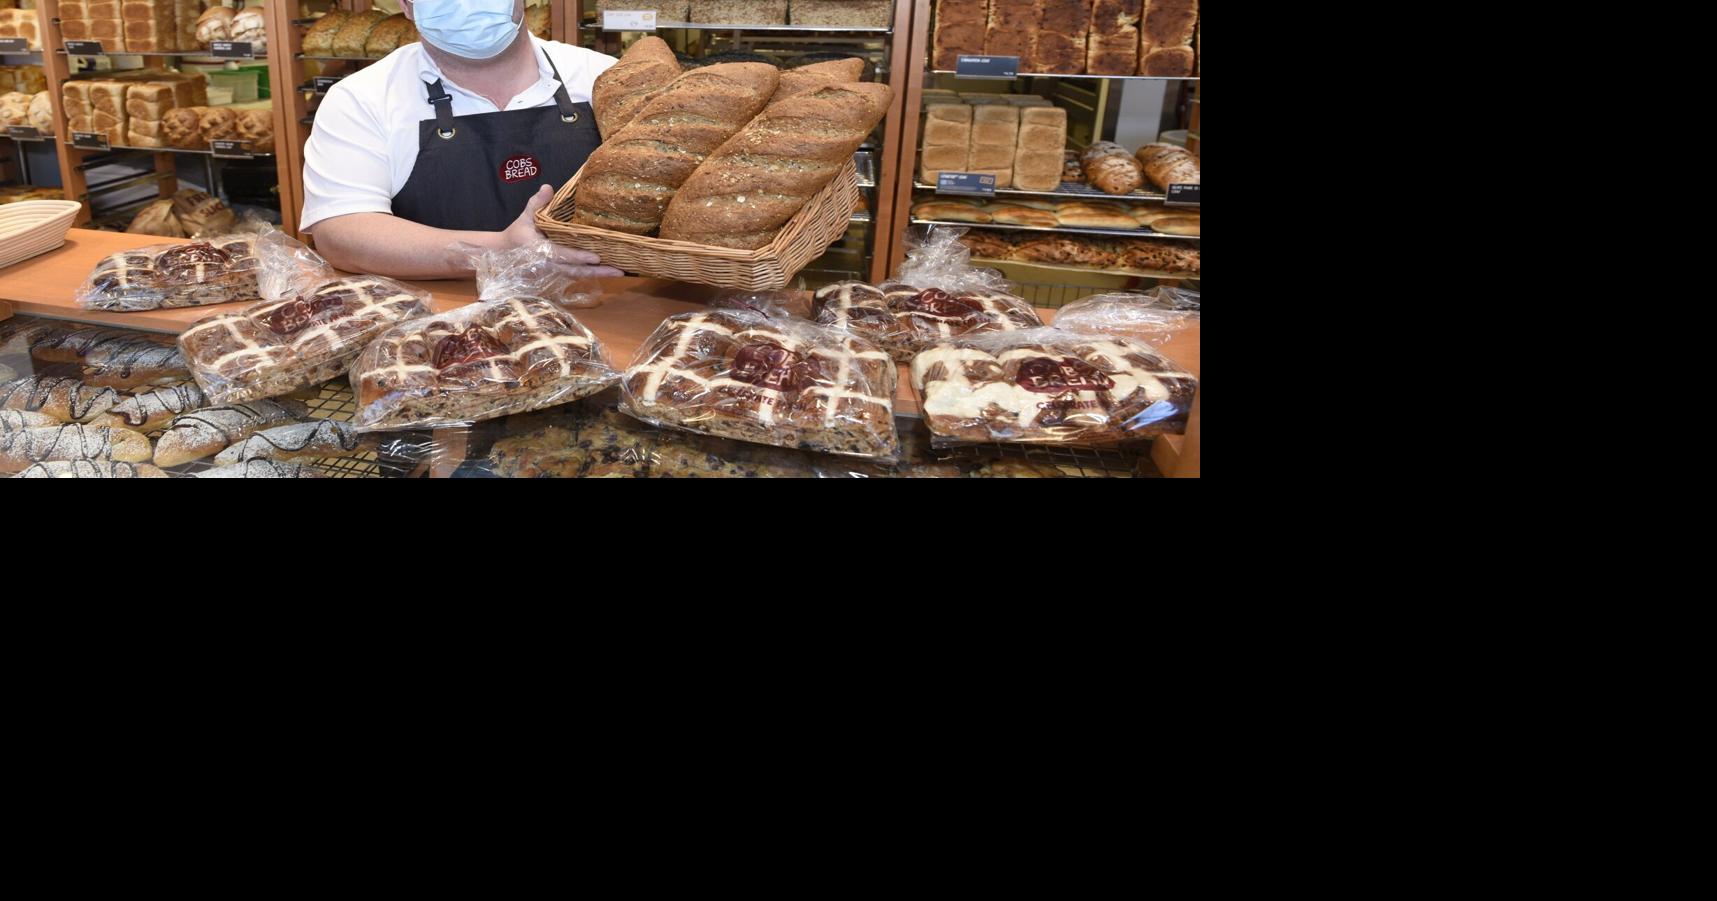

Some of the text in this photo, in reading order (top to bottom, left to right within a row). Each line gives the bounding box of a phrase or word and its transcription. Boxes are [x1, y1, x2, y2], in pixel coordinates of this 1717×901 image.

[506, 158, 533, 170] COBS
[505, 167, 538, 180] BREAD
[1036, 399, 1097, 411] CERATE
